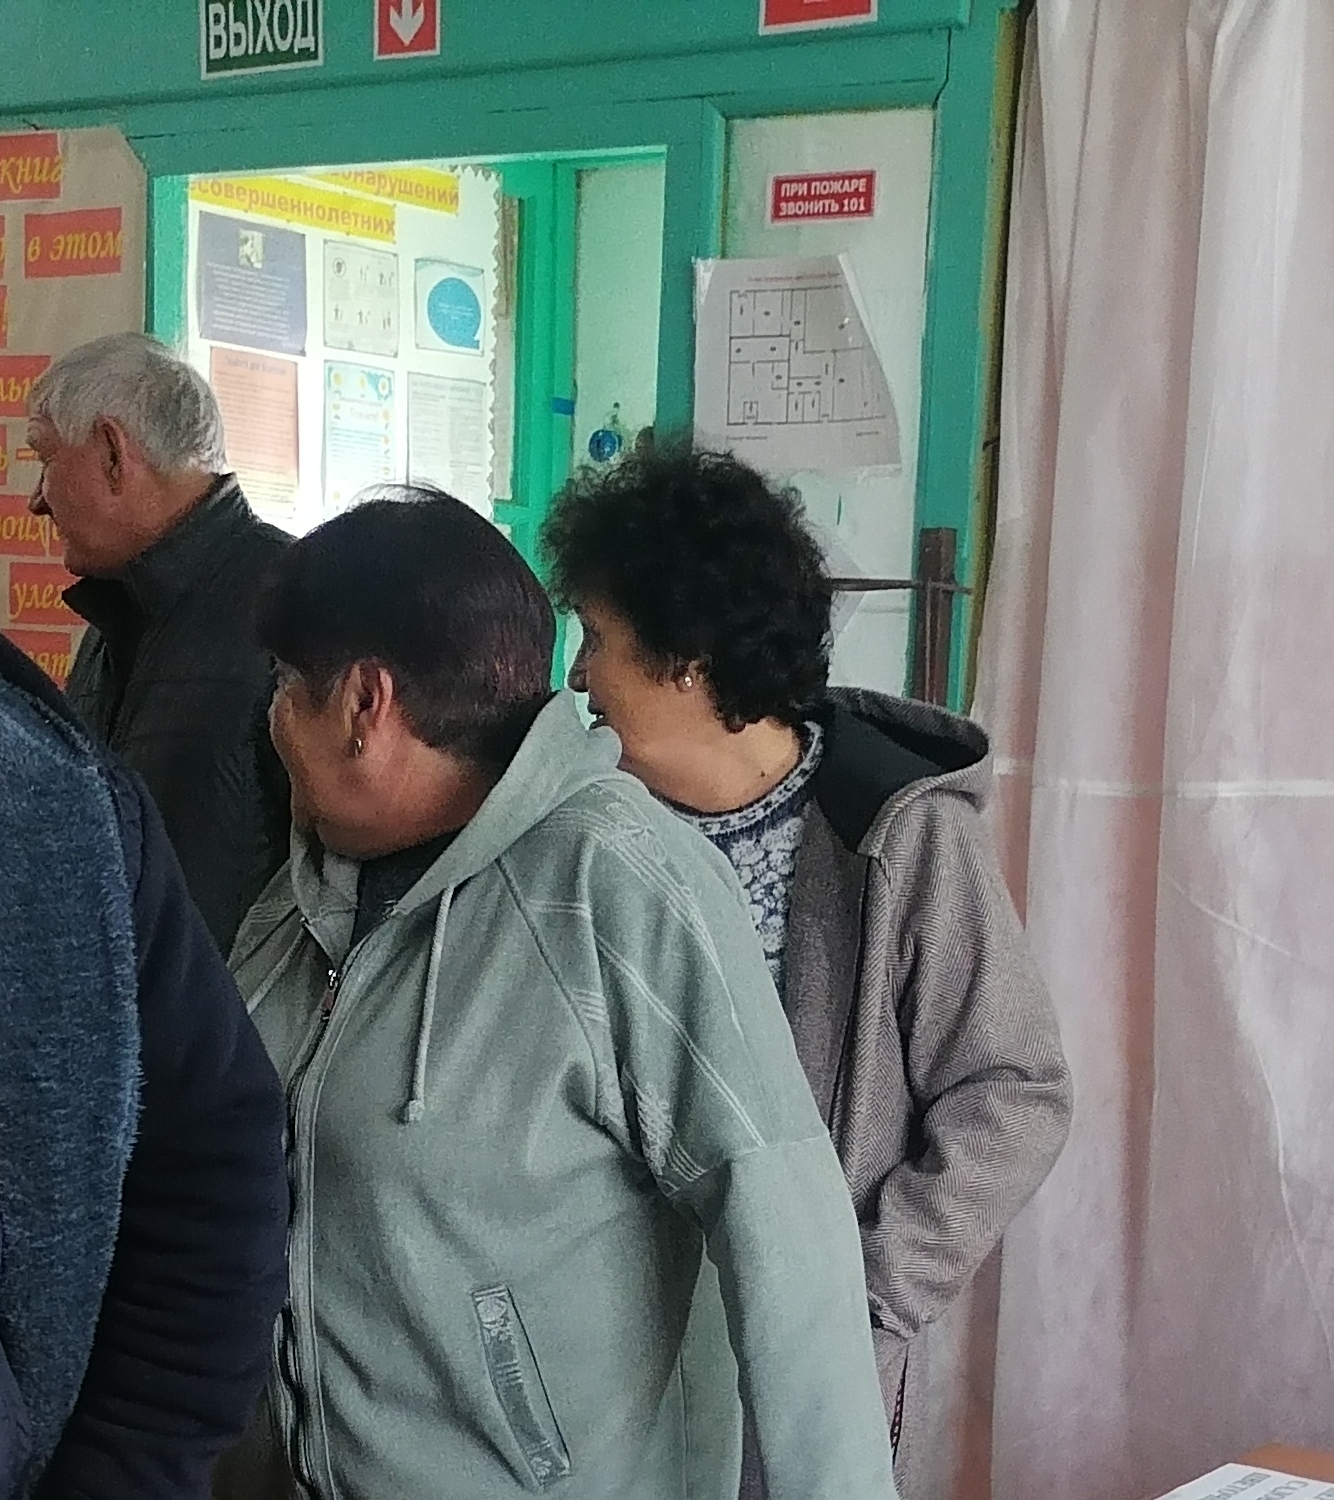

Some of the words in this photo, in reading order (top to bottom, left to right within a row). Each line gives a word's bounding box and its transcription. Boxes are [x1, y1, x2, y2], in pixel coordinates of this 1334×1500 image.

[208, 0, 318, 60] ВЫХОД
[330, 166, 461, 207] онарушений
[780, 182, 808, 198] ПРИ
[810, 178, 867, 196] ПОЖАРЕ
[779, 198, 840, 217] ЗВОНИТЬ
[842, 197, 866, 212] 101
[26, 235, 42, 263] в
[49, 230, 124, 262] этом
